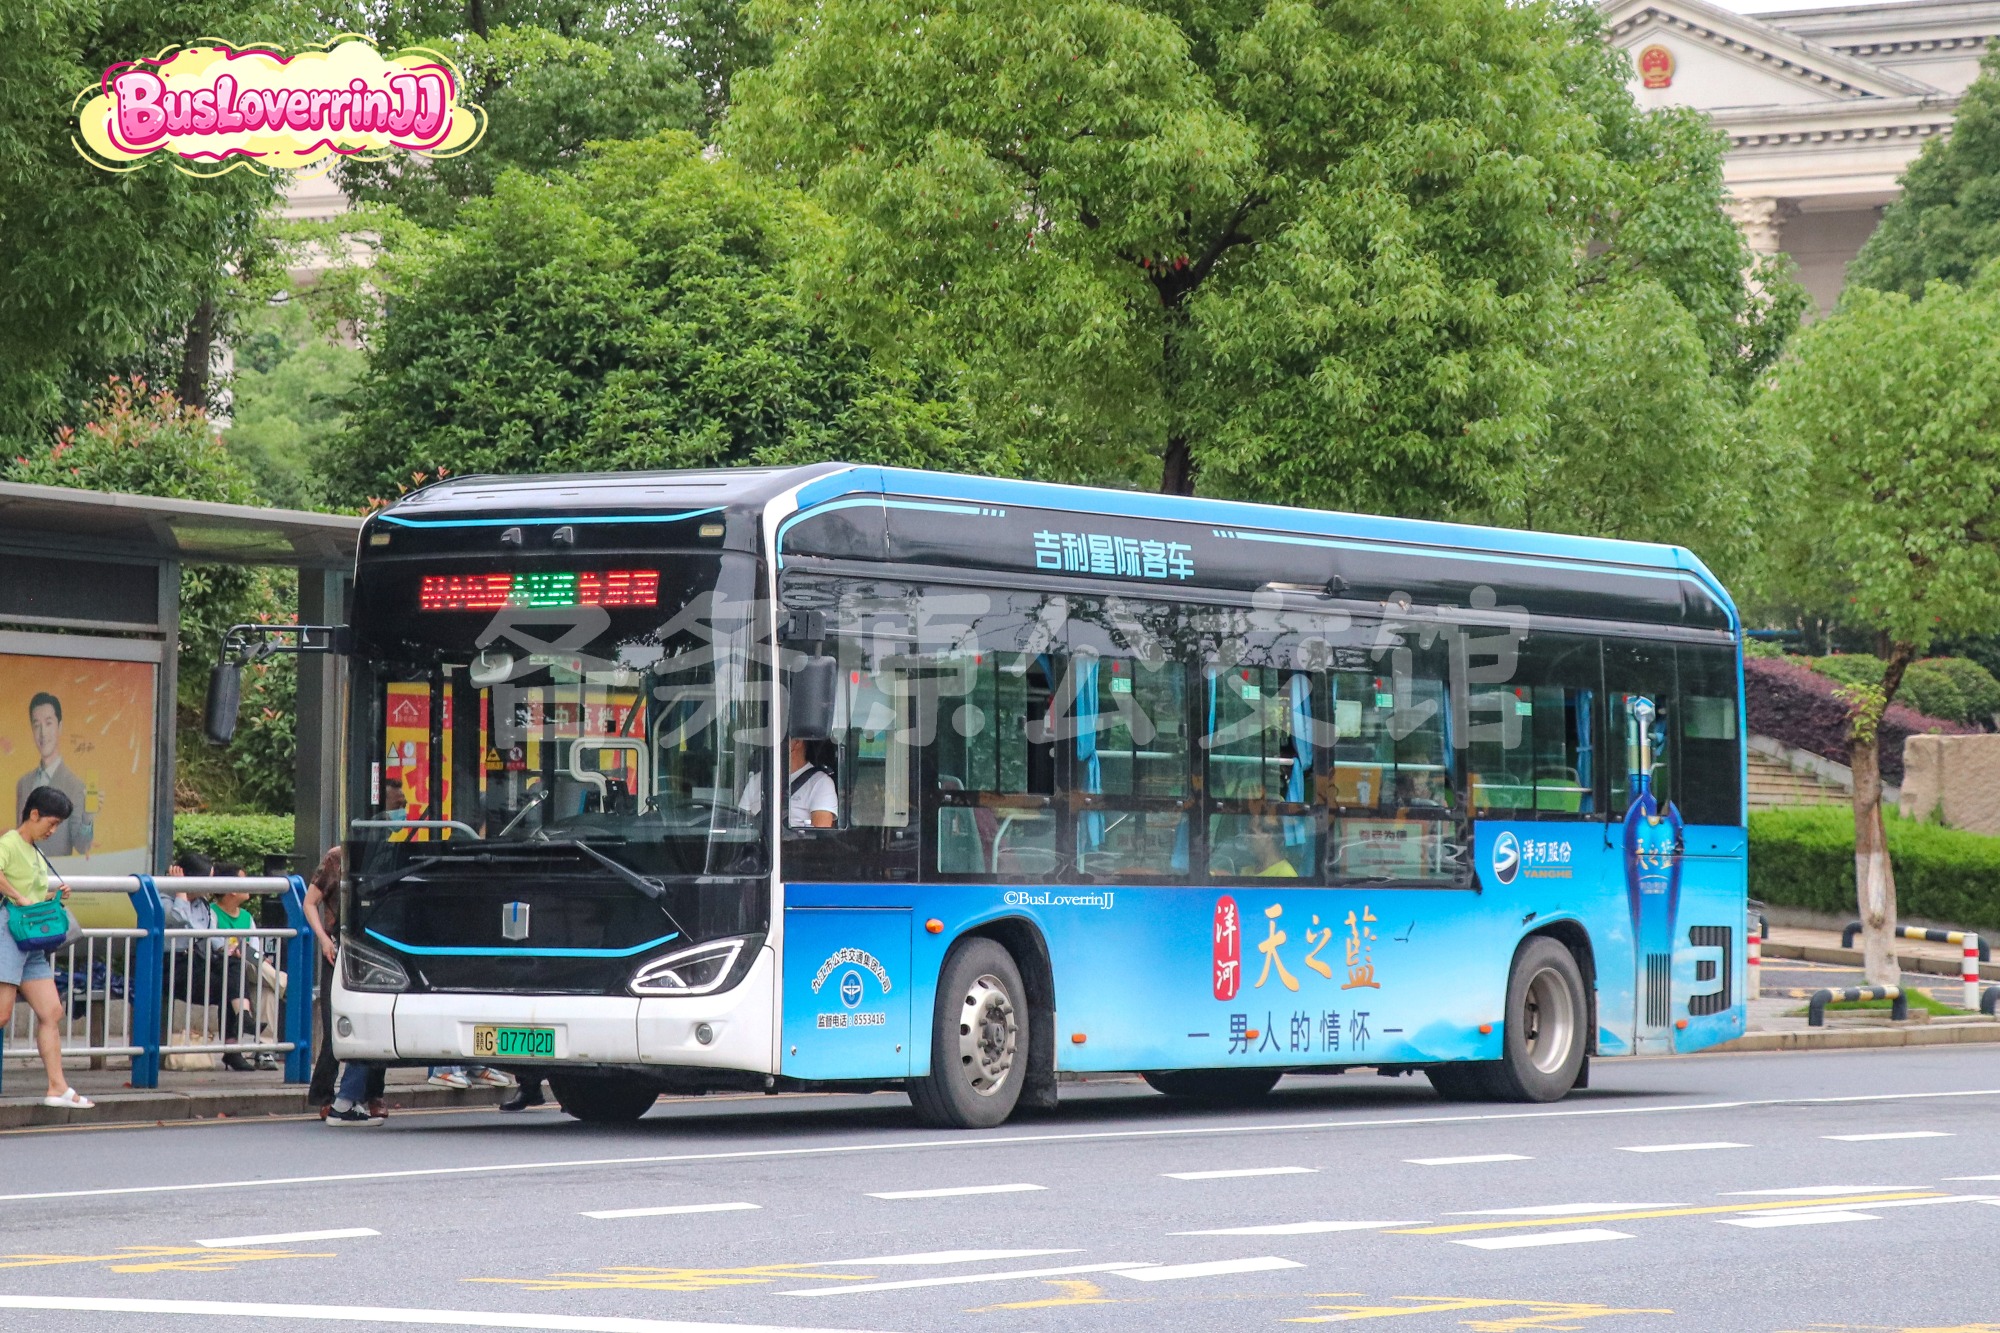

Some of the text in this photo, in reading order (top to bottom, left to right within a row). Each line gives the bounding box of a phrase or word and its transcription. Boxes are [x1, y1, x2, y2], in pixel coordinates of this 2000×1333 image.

[1033, 530, 1195, 580] 吉利星际客车
[1523, 839, 1573, 866] 洋河股份
[1523, 869, 1573, 879] YANGHE
[811, 947, 892, 994] 九江市公共交通集团公司
[1216, 903, 1239, 997] 洋河
